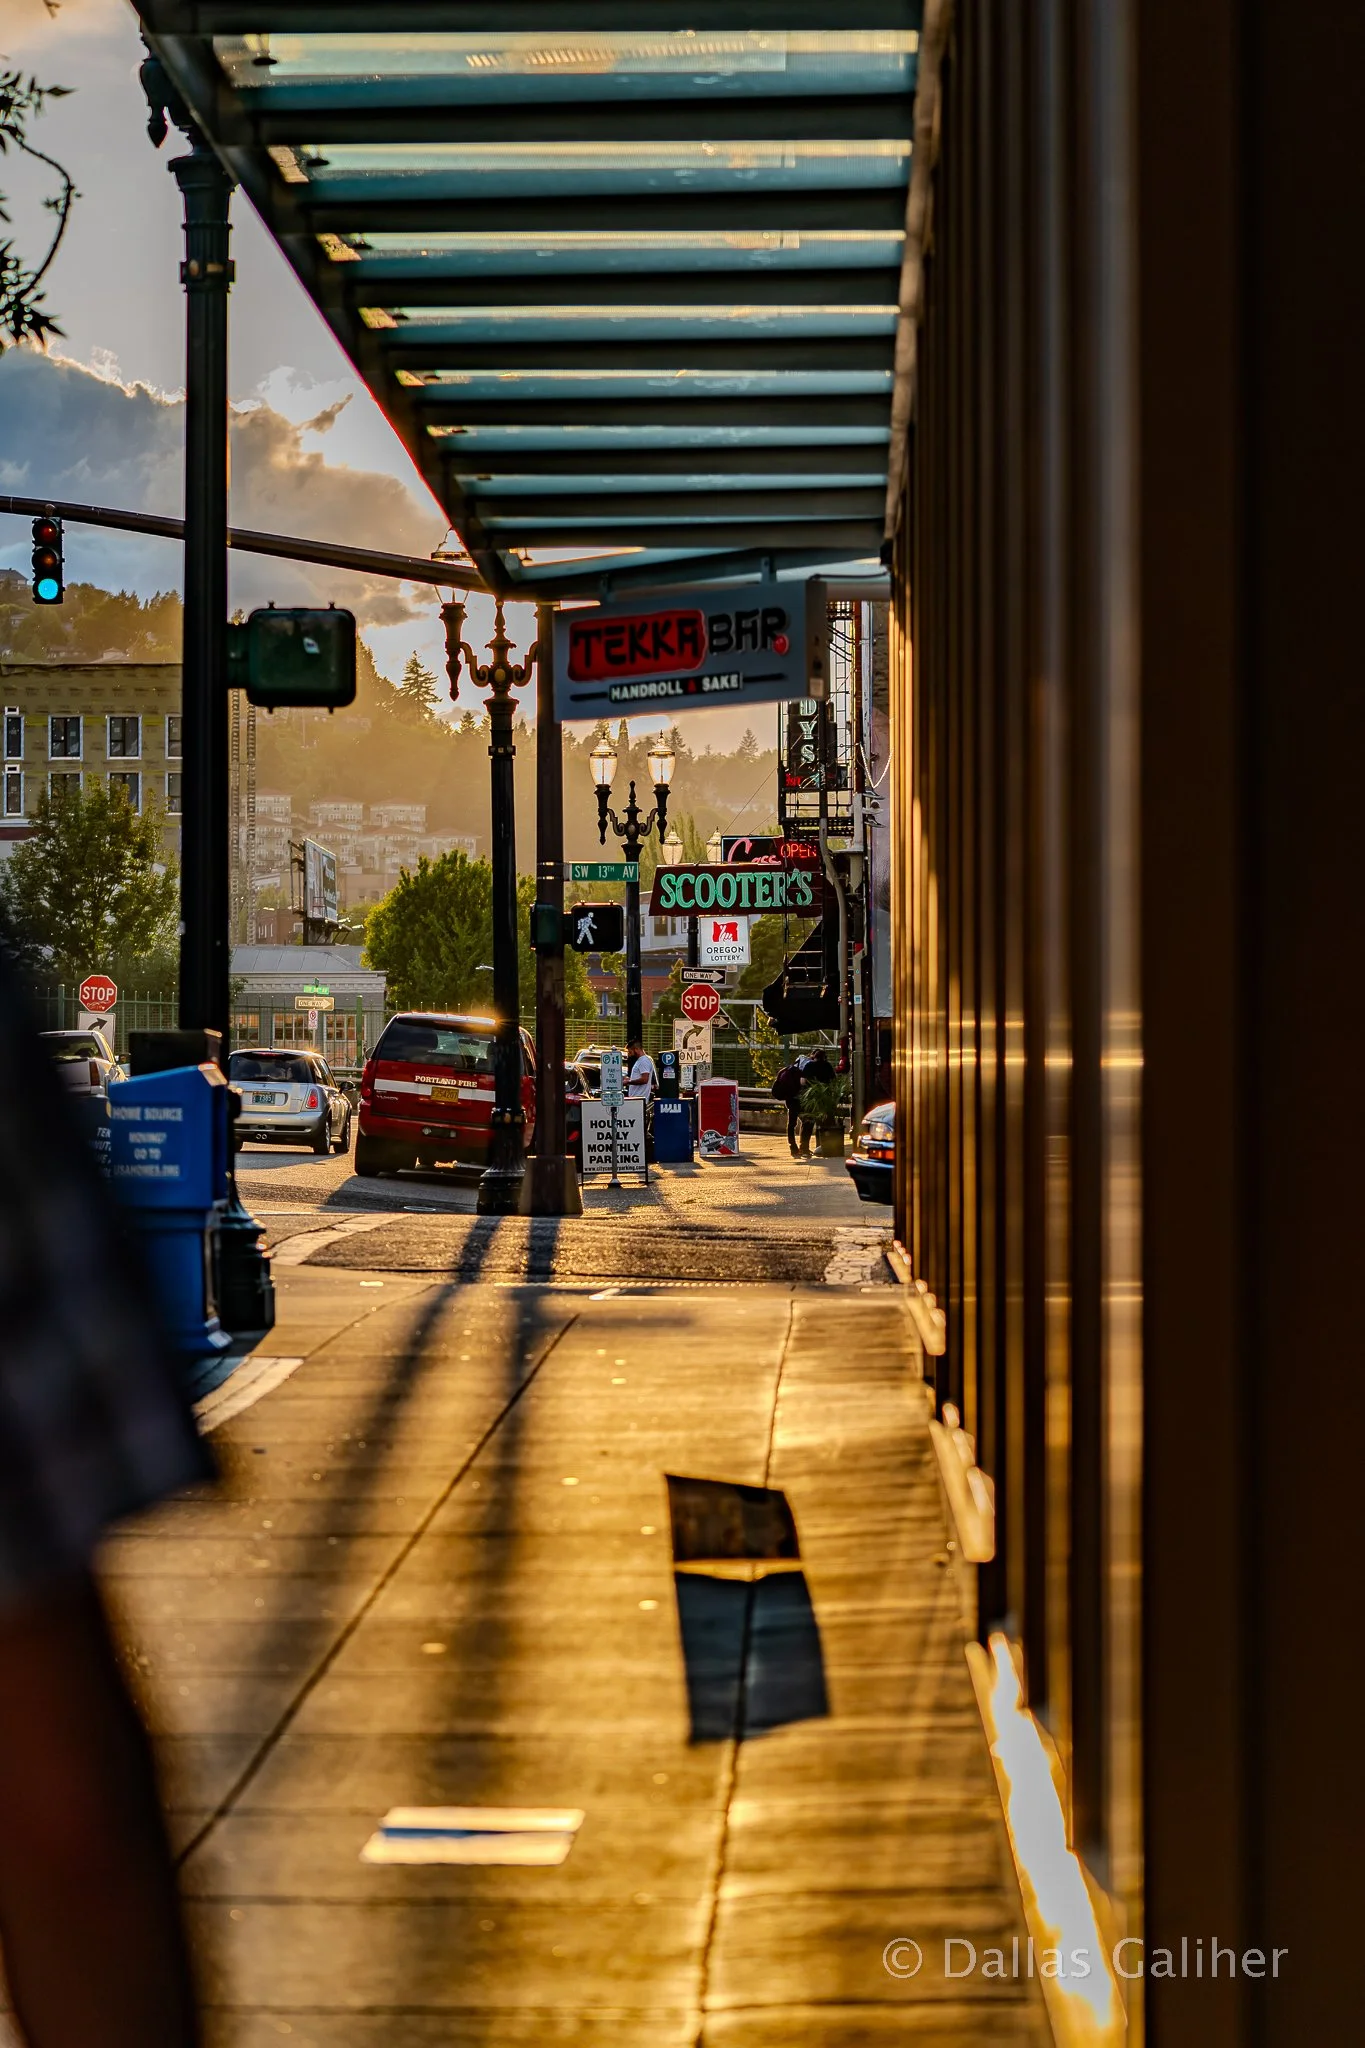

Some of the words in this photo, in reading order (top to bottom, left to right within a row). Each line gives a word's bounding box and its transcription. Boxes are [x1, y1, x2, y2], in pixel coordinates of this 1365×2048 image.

[572, 617, 699, 669] TEKKA
[707, 606, 788, 654] BAR
[611, 681, 683, 701] HANDROLL
[702, 674, 739, 692] SAKE
[780, 843, 817, 858] OPEN
[574, 865, 589, 878] SW
[598, 865, 615, 878] 13TH
[622, 865, 635, 879] AV
[660, 868, 812, 909] SCOOTER'S
[706, 946, 744, 954] OREGON
[82, 986, 115, 1001] STOP
[684, 995, 717, 1010] STOP
[679, 1052, 706, 1060] ONLY
[414, 1075, 456, 1086] PORTLAND
[458, 1080, 478, 1088] FIRE
[596, 1131, 629, 1141] DALY
